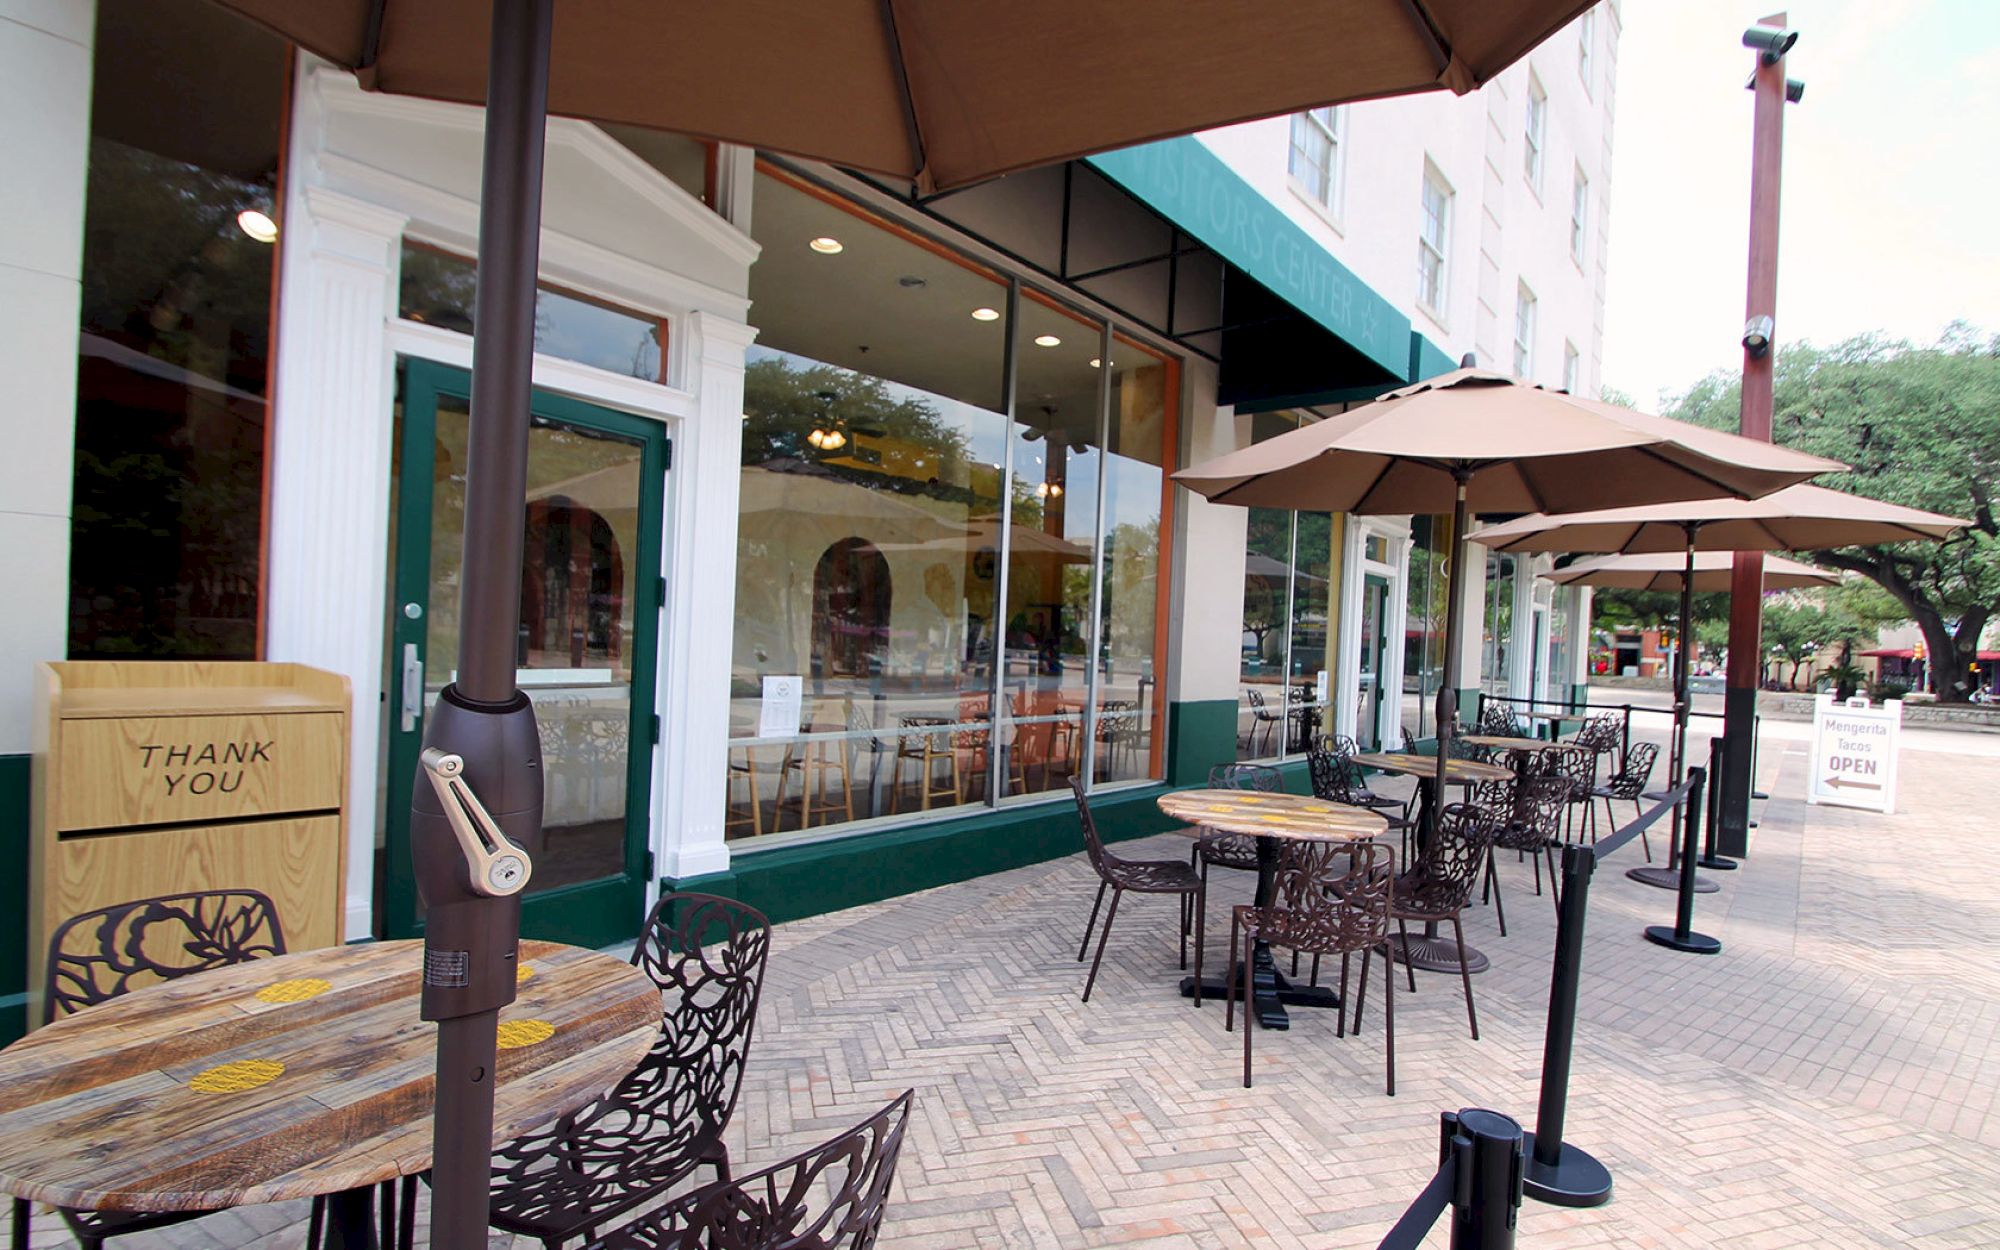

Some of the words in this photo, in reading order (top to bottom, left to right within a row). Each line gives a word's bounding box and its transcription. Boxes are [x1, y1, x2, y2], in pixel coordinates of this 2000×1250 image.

[1272, 232, 1352, 327] CENTER
[1825, 719, 1887, 736] Mengerita
[139, 741, 275, 768] THANK
[1838, 738, 1872, 752] Tacos
[1829, 756, 1877, 775] OPEN
[165, 770, 244, 796] YOU
